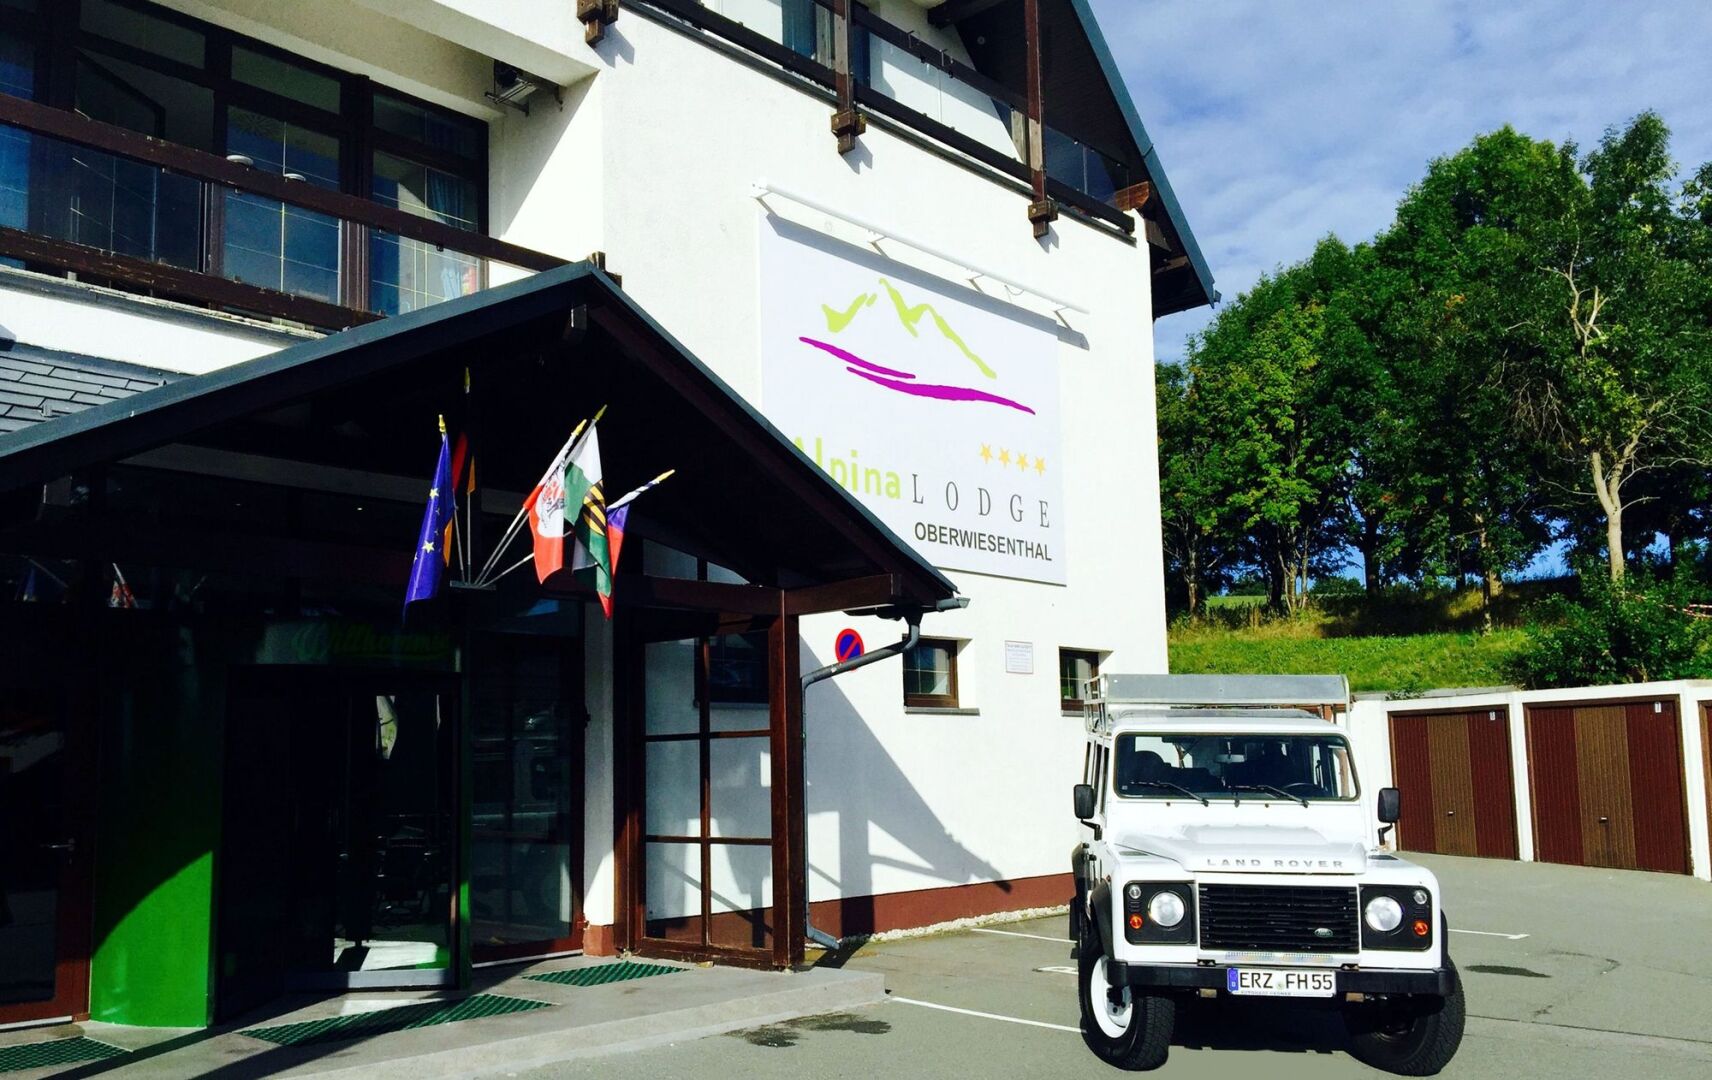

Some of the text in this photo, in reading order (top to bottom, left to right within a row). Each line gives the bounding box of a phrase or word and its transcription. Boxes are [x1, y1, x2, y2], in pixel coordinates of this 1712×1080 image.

[912, 474, 1050, 528] LODGE
[914, 522, 1052, 562] OBERWIESENTHAL
[1207, 858, 1343, 868] LAND ROVER
[1240, 972, 1273, 989] ERZ
